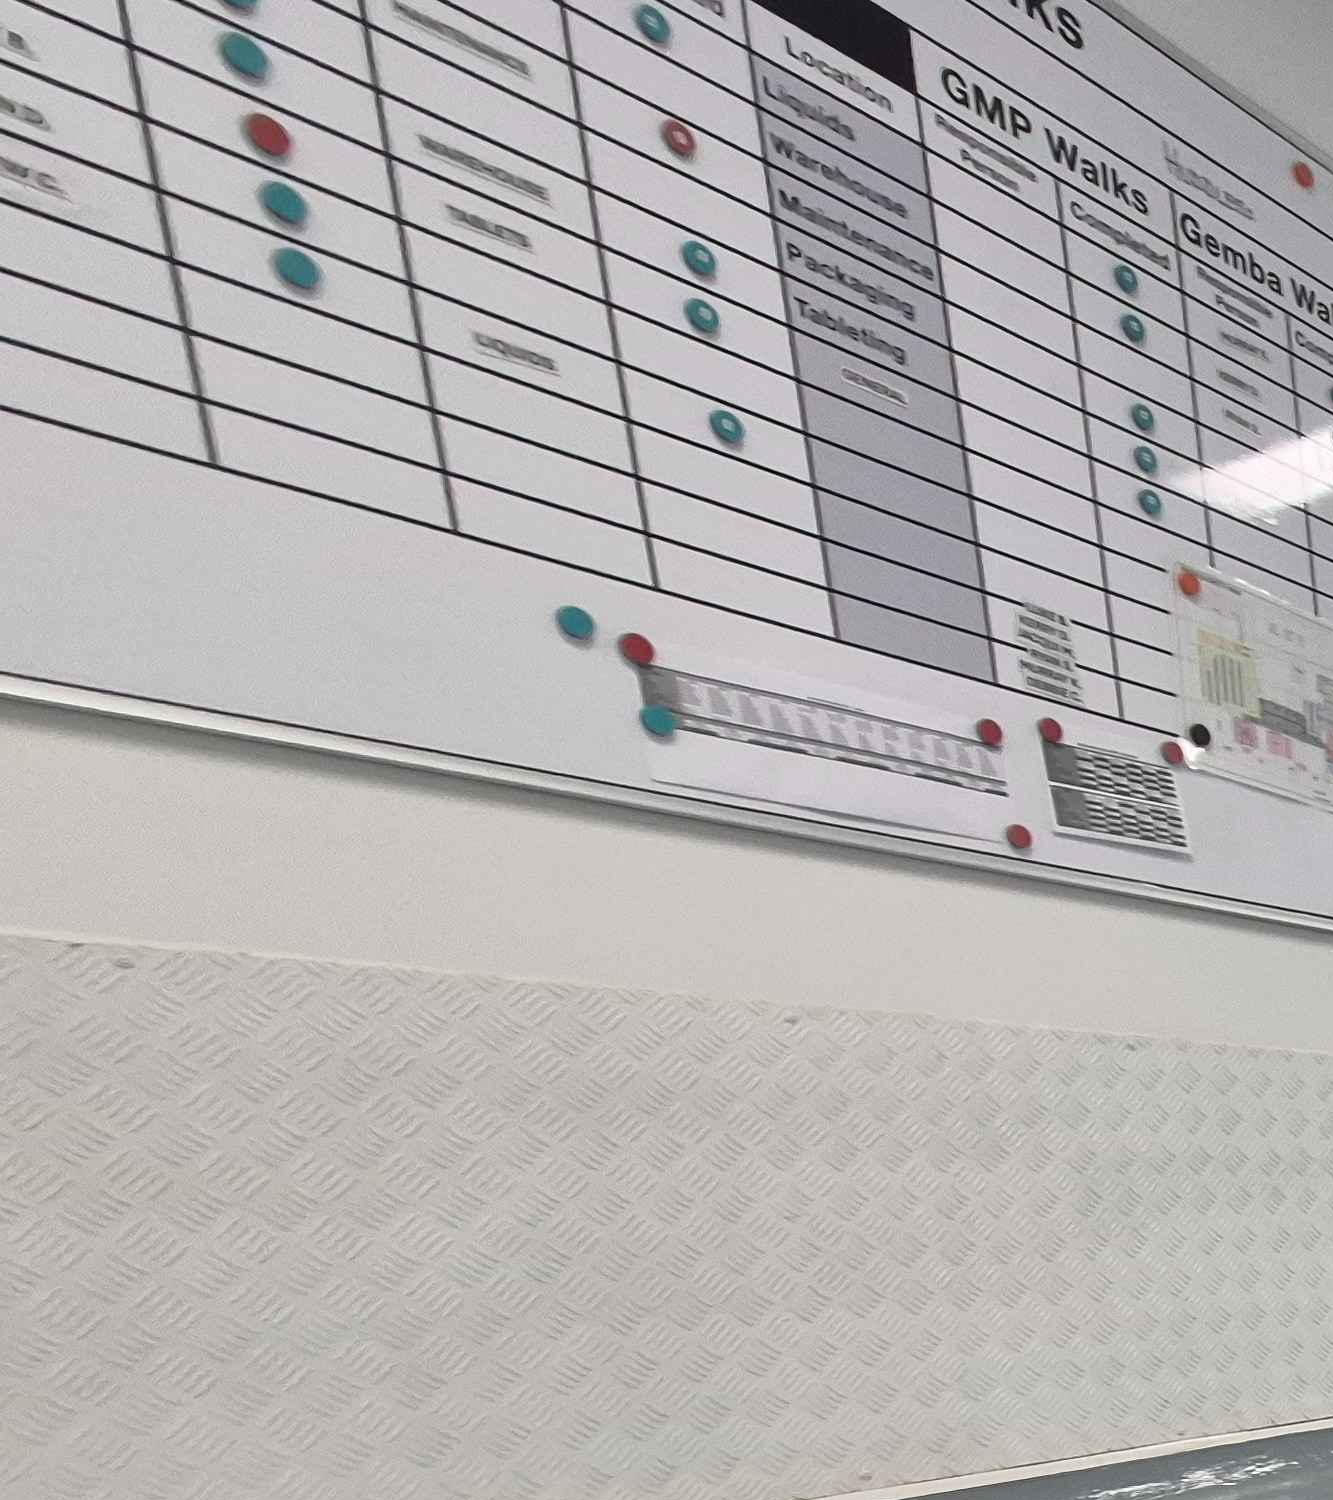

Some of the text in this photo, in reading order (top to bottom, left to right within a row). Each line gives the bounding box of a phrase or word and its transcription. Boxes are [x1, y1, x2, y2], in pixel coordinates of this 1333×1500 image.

[1008, 0, 1084, 49] KS
[784, 36, 893, 113] Location
[940, 67, 1032, 139] GMP
[1045, 127, 1149, 216] Walks
[786, 242, 916, 321] Packaging
[1180, 213, 1284, 297] Gemba
